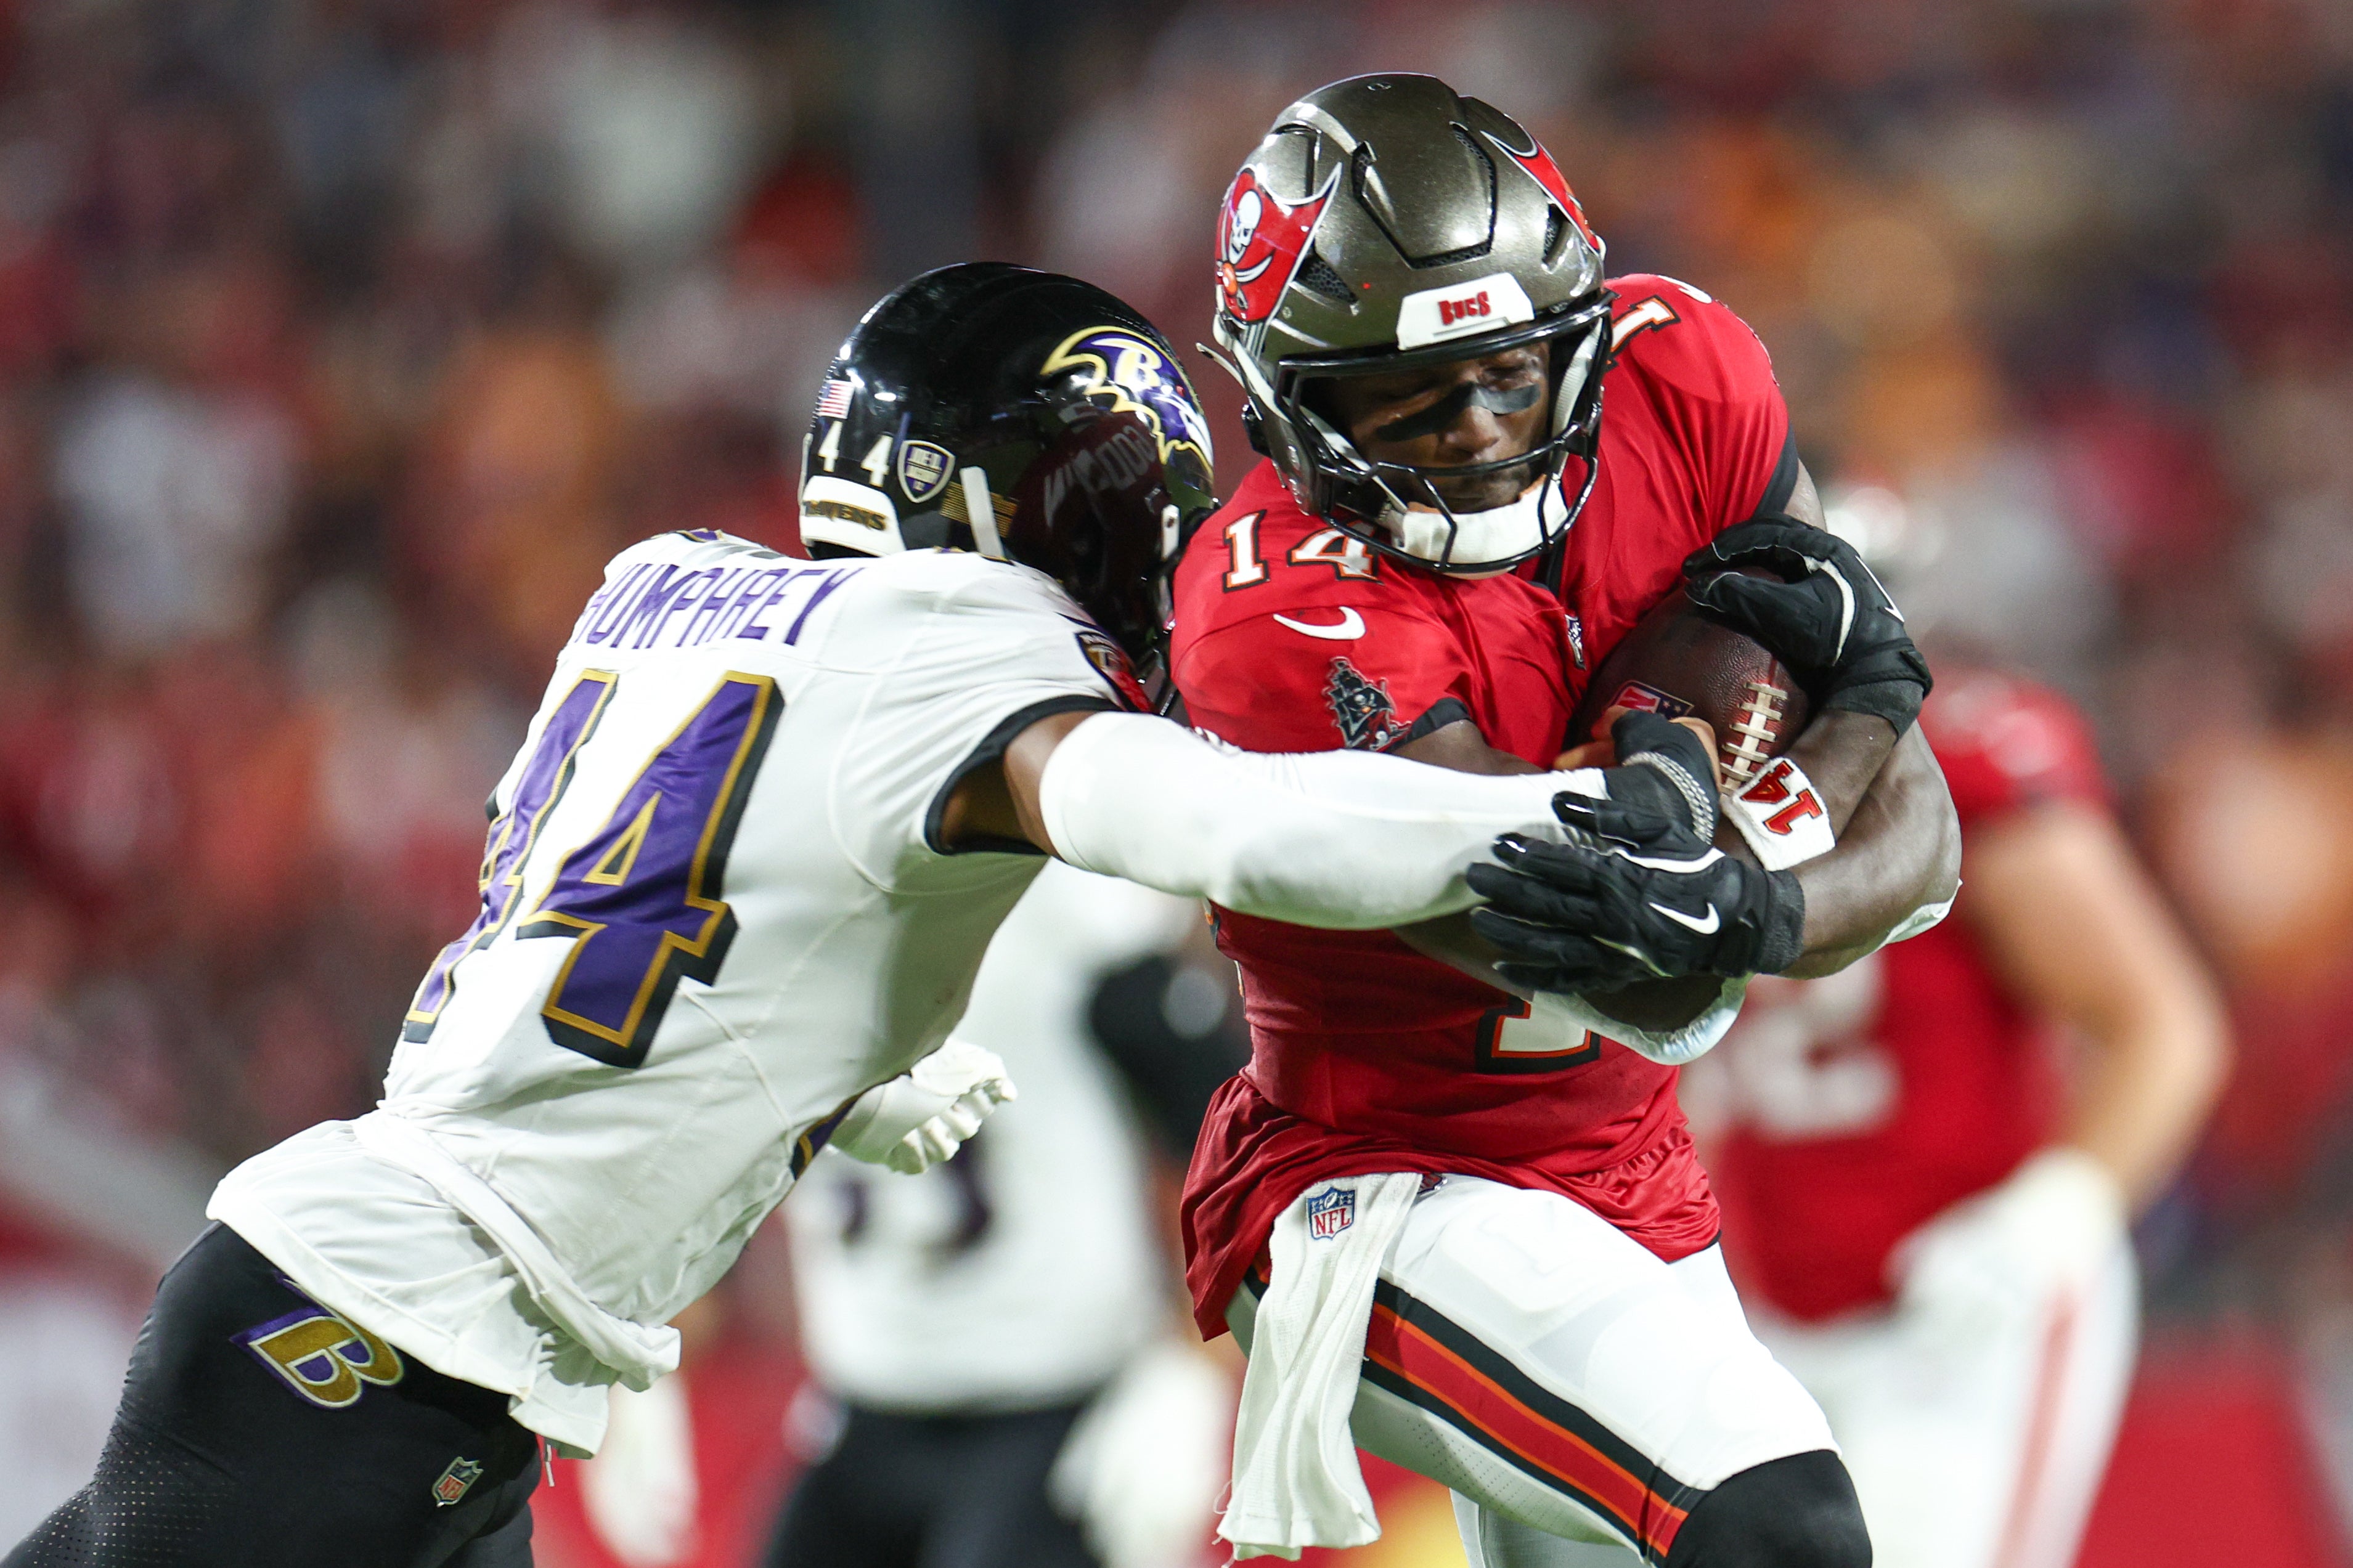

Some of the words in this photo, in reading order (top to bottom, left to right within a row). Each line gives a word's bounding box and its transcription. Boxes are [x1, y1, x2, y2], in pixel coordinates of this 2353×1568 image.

[817, 420, 894, 489] 44
[1222, 509, 1384, 593] 14
[1740, 760, 1823, 835] 14
[1313, 1208, 1350, 1236] NFL
